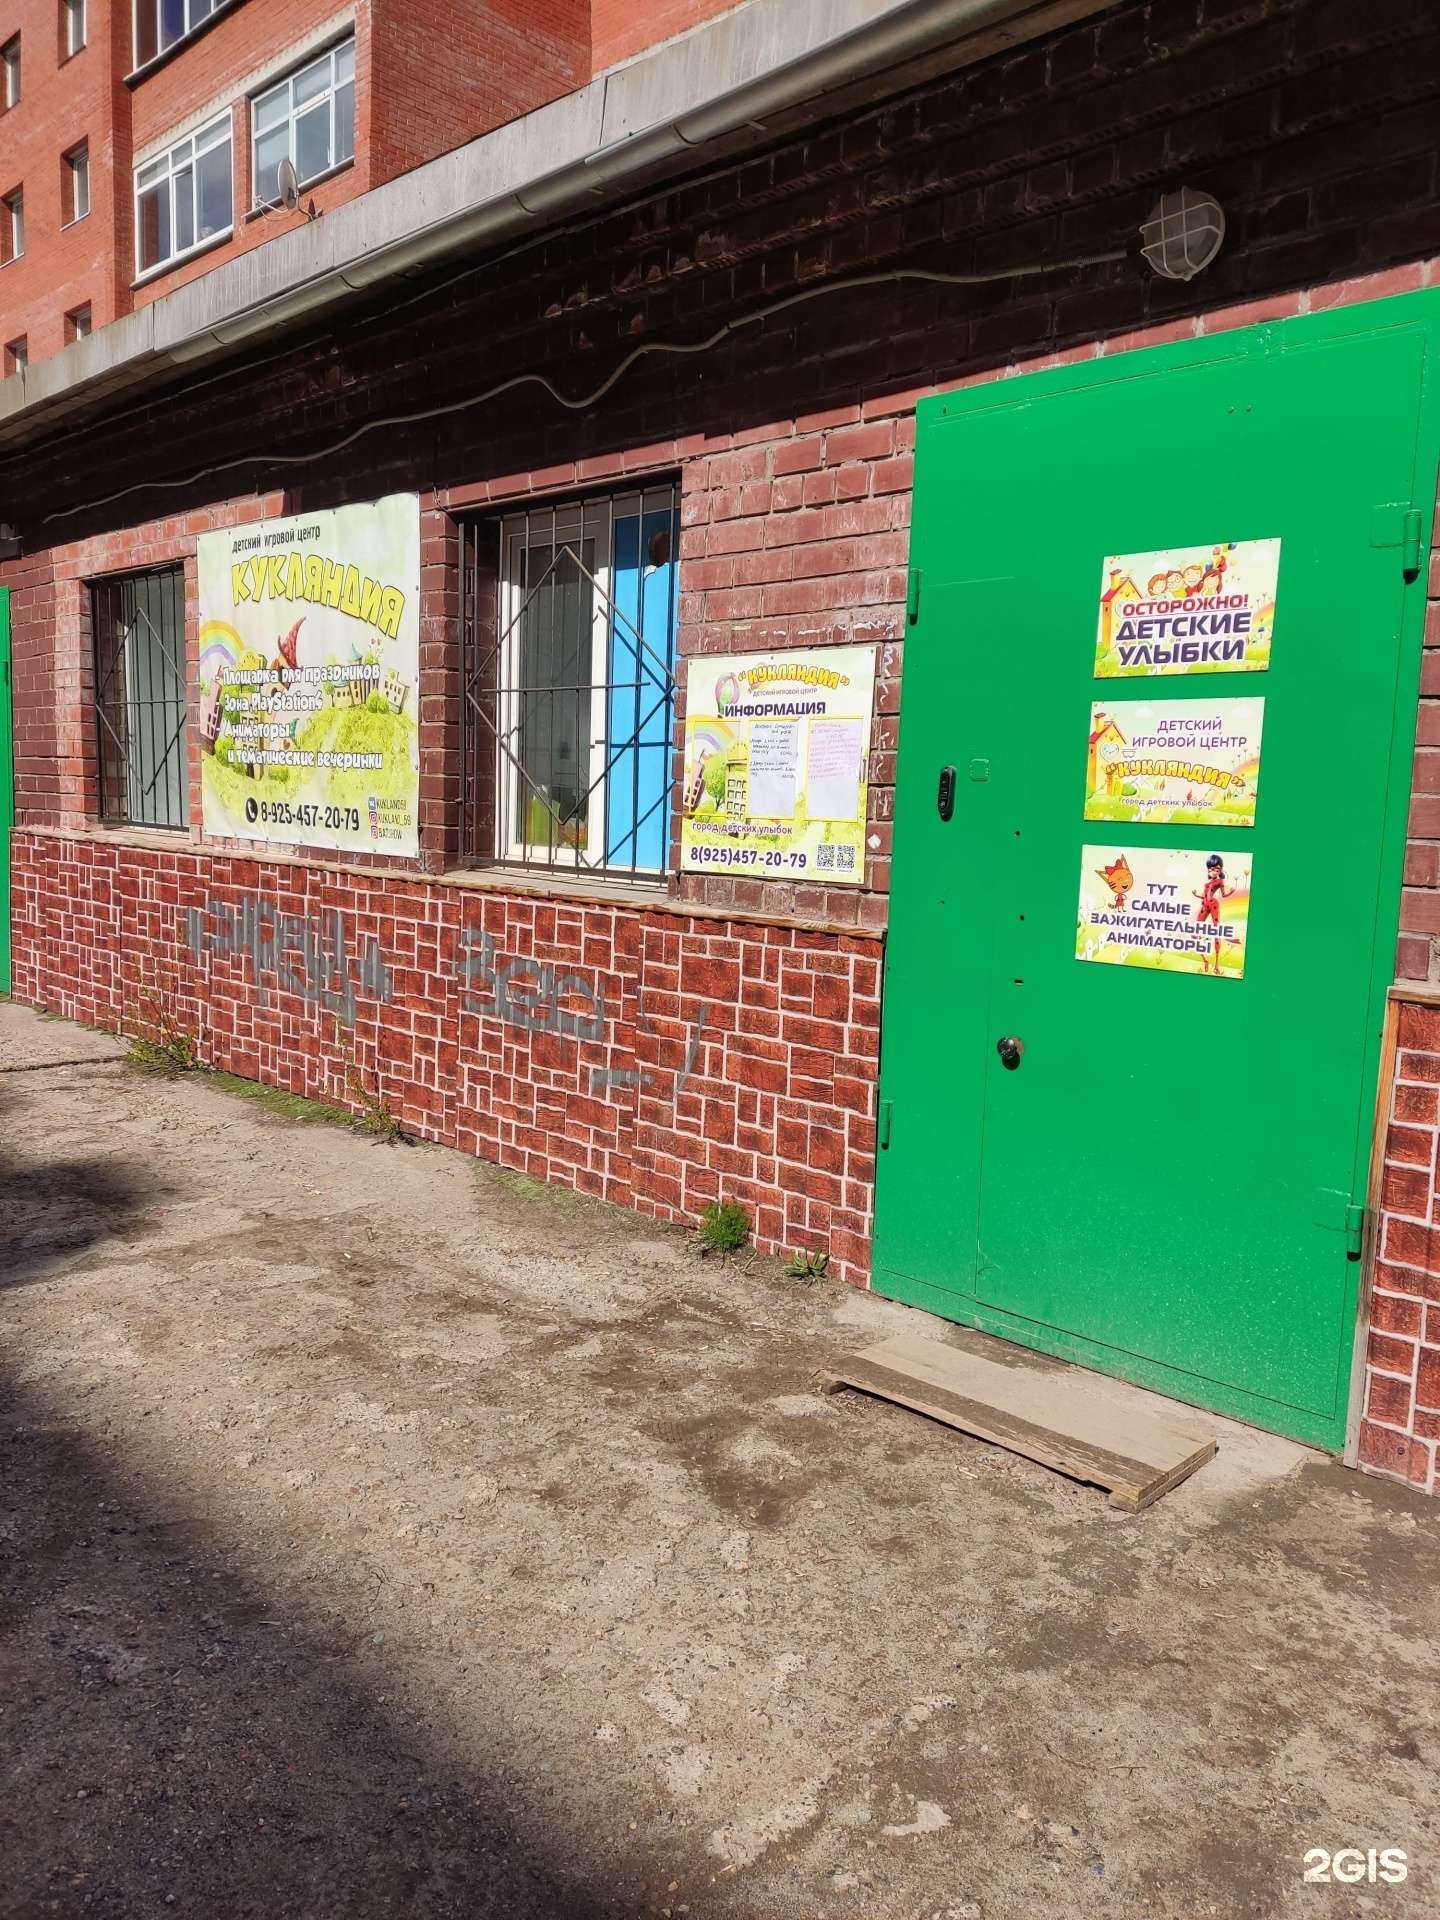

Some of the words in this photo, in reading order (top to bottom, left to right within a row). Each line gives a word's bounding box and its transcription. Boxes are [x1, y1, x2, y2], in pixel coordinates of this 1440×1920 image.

[231, 534, 261, 554] детский
[264, 528, 295, 549] игровой
[297, 524, 321, 544] центр
[231, 551, 405, 640] КУКЛЯНДИЯ
[1122, 594, 1249, 619] ОСТОРОЖНО!
[1116, 612, 1251, 641] ДЕТСКИЕ
[1118, 639, 1246, 666] УЛЫБКИ
[223, 667, 279, 686] Площадка
[282, 668, 301, 683] для
[305, 664, 381, 687] праздников
[224, 694, 249, 711] Зона
[725, 702, 826, 718] ИНФОРМАЦИЯ
[223, 722, 290, 742] Аниматоры
[1157, 716, 1222, 733] ДЕТСКИЙ
[1132, 734, 1195, 748] ИГРОВОЙ
[1200, 736, 1247, 750] ЦЕНТР
[228, 749, 234, 762] и
[236, 748, 314, 767] тематические
[317, 752, 383, 773] вечеринки
[261, 801, 360, 831] 8-925-457-20-79
[692, 822, 719, 834] город
[720, 823, 756, 834] детских
[757, 825, 793, 835] улыбок
[690, 847, 807, 869] 8(925)457-20-79
[1146, 883, 1178, 898] ТУТ
[1131, 899, 1191, 917] САМЫЕ
[1090, 912, 1235, 938] ЗАЖИГАТЕЛЬНЫЕ
[1106, 930, 1212, 954] АНИМАТОРЫ
